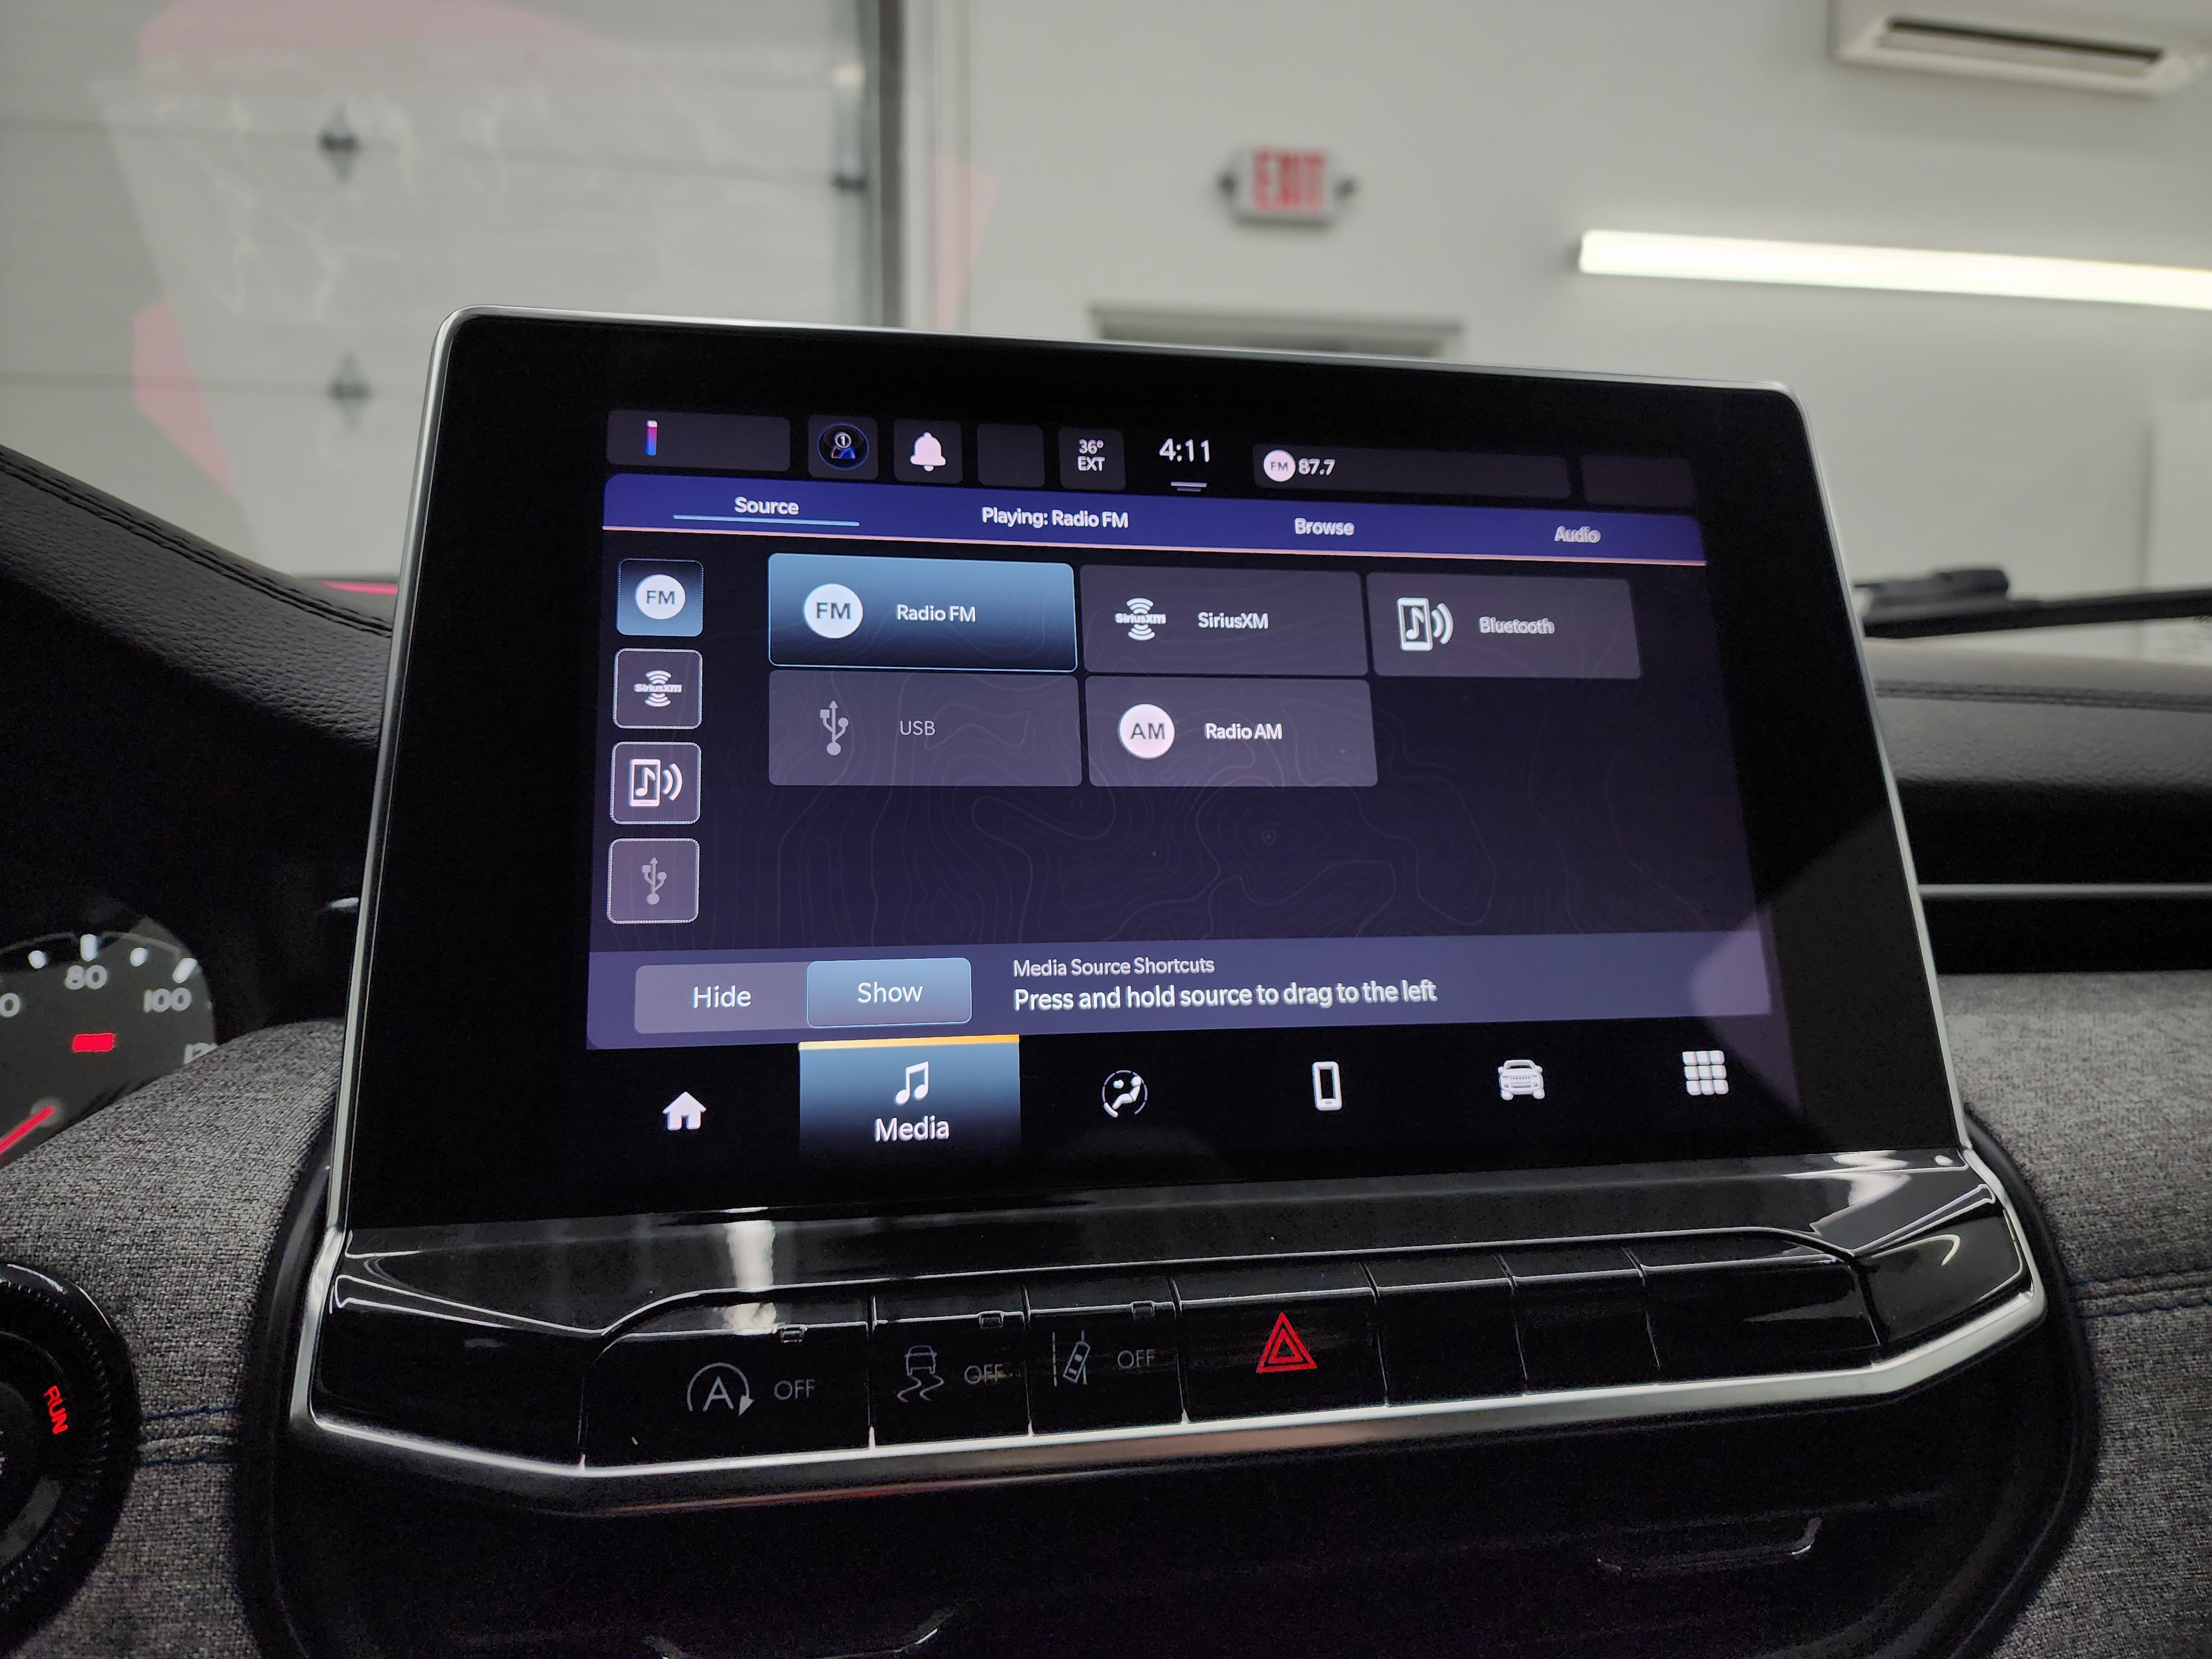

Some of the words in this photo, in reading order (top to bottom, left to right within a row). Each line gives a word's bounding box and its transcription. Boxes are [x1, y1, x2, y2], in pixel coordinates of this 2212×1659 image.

[1253, 148, 1324, 213] EXIT
[1159, 438, 1211, 463] 4:11
[1077, 457, 1105, 472] EXT
[1270, 461, 1289, 471] FM
[1298, 458, 1335, 476] 87.7
[734, 497, 800, 515] Source
[982, 507, 1048, 529] Playing:
[1052, 510, 1099, 528] Radio
[1102, 512, 1129, 528] FM
[1295, 518, 1355, 536] Browse
[1554, 526, 1601, 544] Audio
[646, 591, 675, 605] FM
[816, 602, 851, 620] FM
[897, 604, 946, 622] Radio
[950, 607, 975, 623] FM
[1198, 612, 1269, 630] SiriusXM
[1479, 617, 1555, 635] Bluetooth
[900, 720, 936, 737] USB
[1130, 723, 1165, 740] AM
[1205, 722, 1252, 740] Radio
[1254, 723, 1282, 740] AM
[65, 965, 108, 989] 80
[1013, 959, 1067, 978] Media
[1071, 959, 1131, 975] Source
[1134, 957, 1215, 974] Shortcuts
[144, 987, 192, 1013] 100
[692, 985, 752, 1009] Hide
[857, 982, 923, 1004] Show
[1014, 988, 1074, 1011] Press
[1078, 985, 1120, 1010] and
[1126, 985, 1175, 1008] hold
[1180, 988, 1253, 1006] source
[1256, 985, 1277, 1005] to
[1282, 982, 1333, 1008] drag
[1337, 983, 1359, 1003] to
[1361, 981, 1398, 1003] the
[1400, 979, 1438, 1003] left
[874, 1115, 950, 1142] Media
[1117, 1349, 1156, 1369] OFF
[964, 1364, 1004, 1384] OFF
[774, 1379, 816, 1401] OFF
[43, 1385, 69, 1434] RUN
